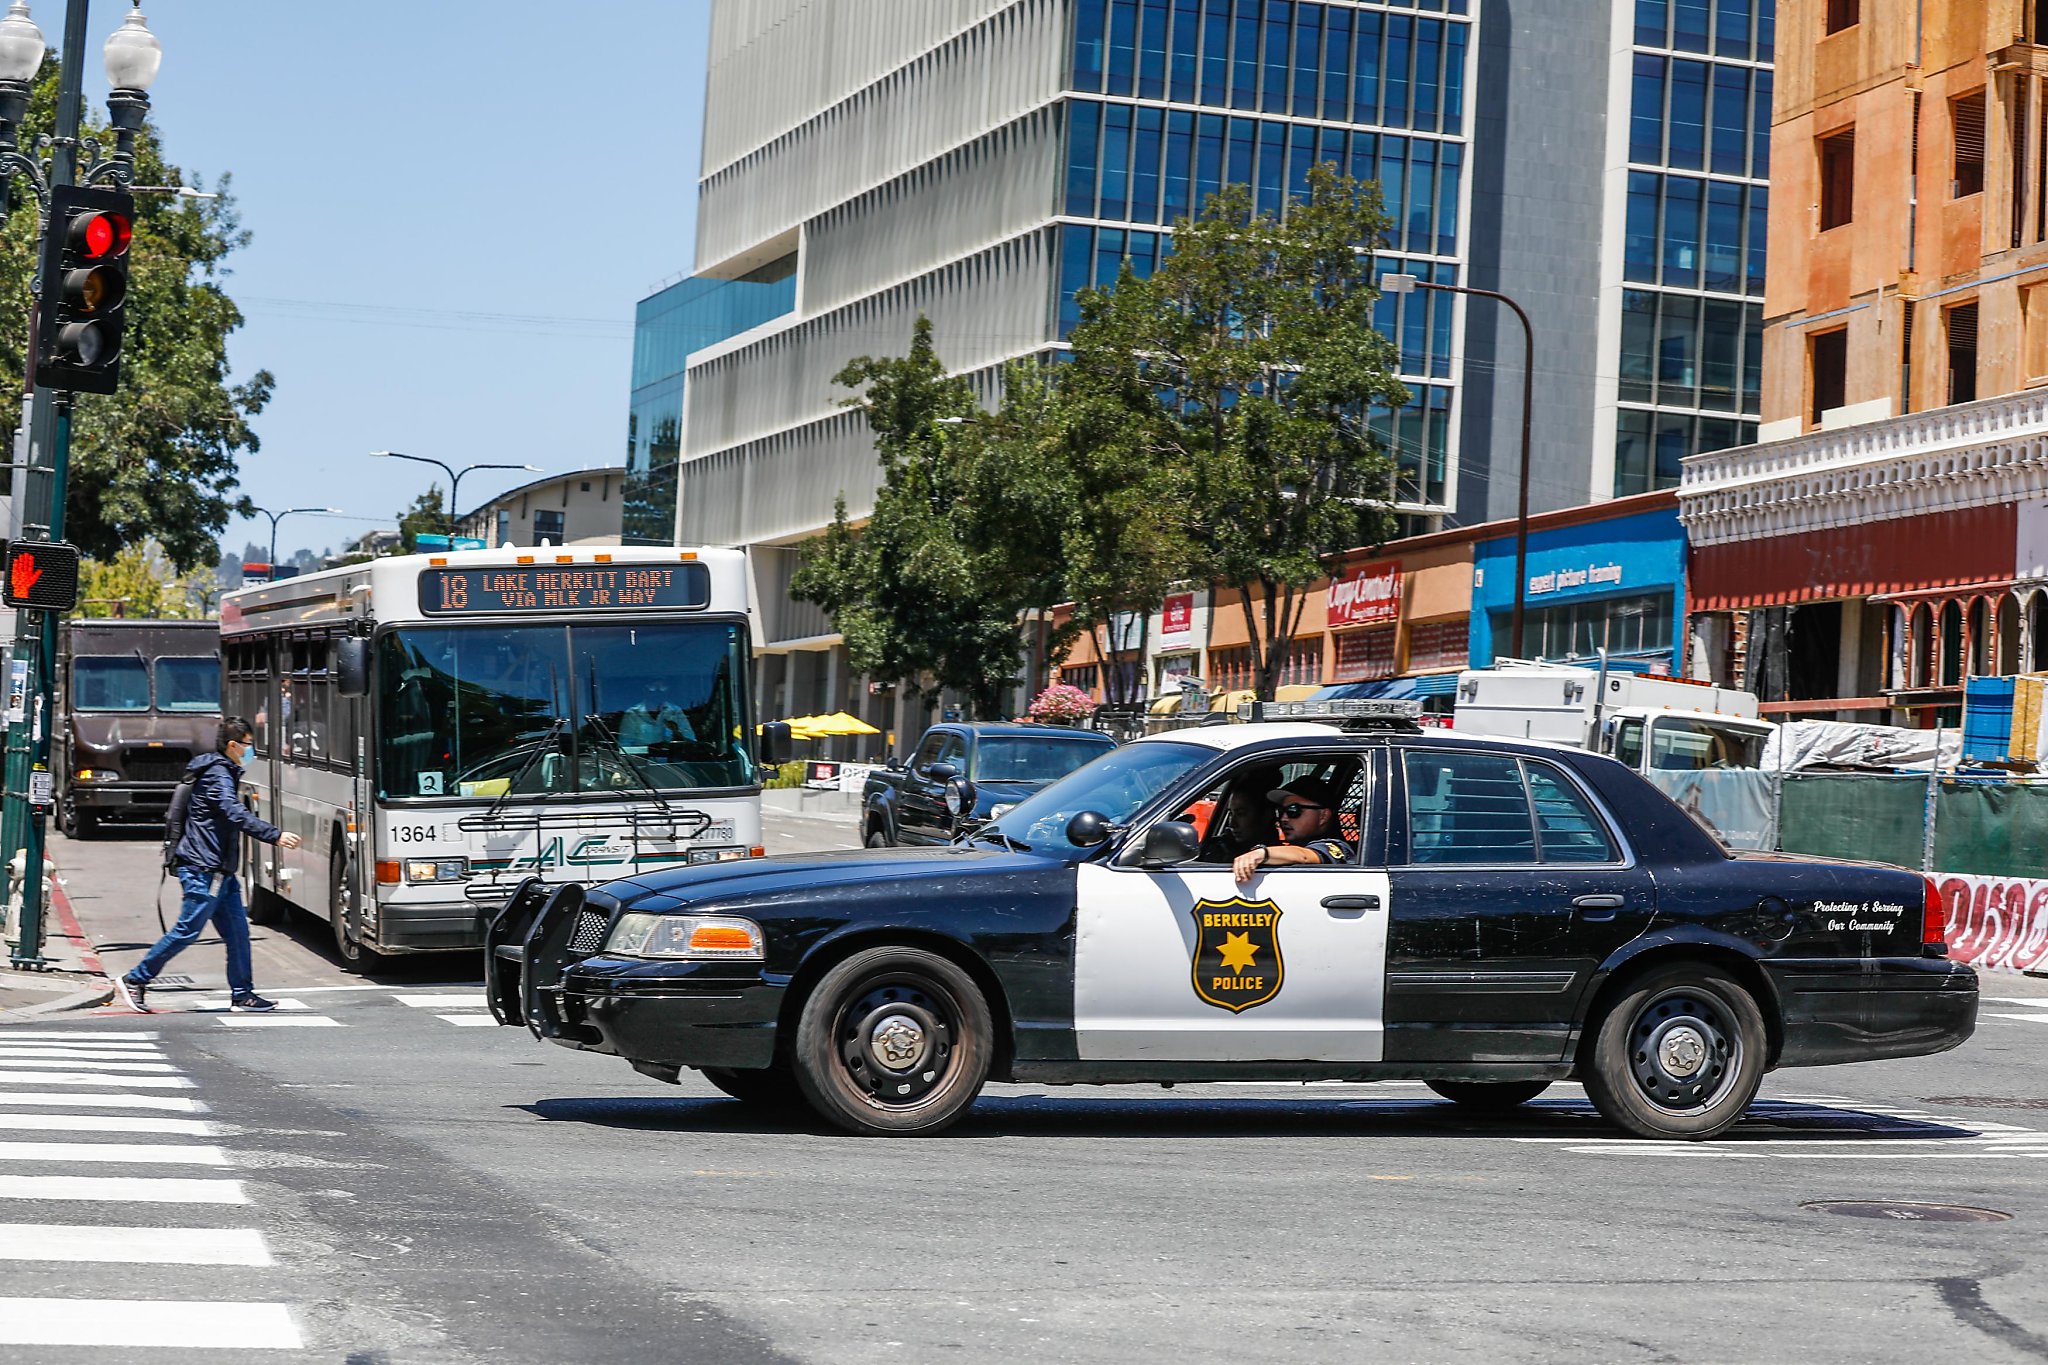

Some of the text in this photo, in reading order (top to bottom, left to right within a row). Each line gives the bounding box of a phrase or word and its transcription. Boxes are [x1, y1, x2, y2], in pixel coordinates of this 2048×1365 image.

[483, 570, 674, 592] LAKE MERRITT BART
[1528, 561, 1622, 594] expert picture framing
[440, 575, 468, 609] 18
[501, 589, 656, 607] VIA MLK JR WAY
[423, 775, 438, 792] 2
[391, 825, 437, 843] 1364
[583, 844, 633, 856] TRANSIT
[1813, 900, 1904, 916] Protecting & Serving
[1203, 913, 1273, 927] BERKELEY
[1827, 919, 1895, 935] Our Community
[1212, 976, 1264, 990] POLICE
